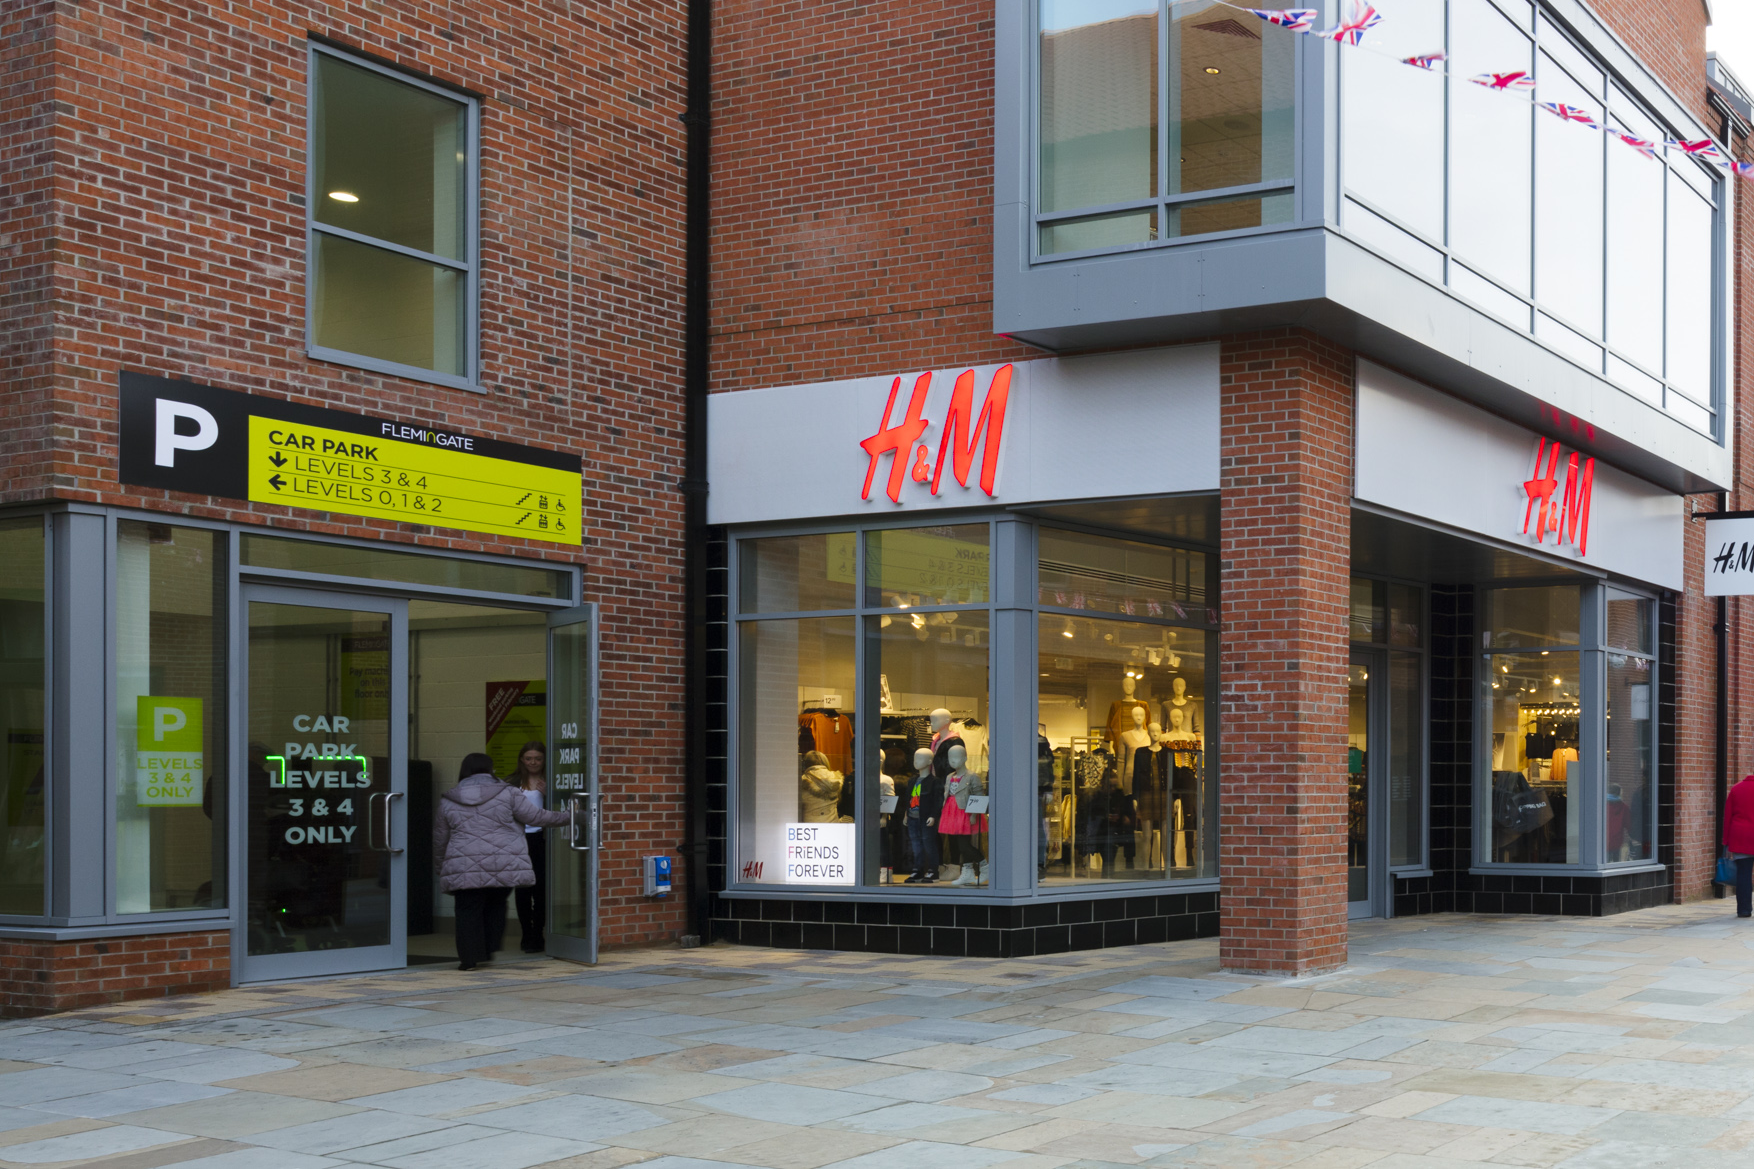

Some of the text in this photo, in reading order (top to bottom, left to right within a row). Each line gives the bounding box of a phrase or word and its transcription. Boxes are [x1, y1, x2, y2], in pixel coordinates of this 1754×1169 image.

[154, 397, 219, 468] P
[381, 422, 474, 451] FLEMINGATE
[859, 363, 1014, 504] H&M
[268, 430, 379, 462] CAR PARK
[294, 455, 428, 490] LEVELS 3 & 4
[293, 477, 442, 513] LEVELS 0, 1 & 2
[1522, 436, 1595, 557] H&M
[488, 687, 506, 711] FREE
[153, 706, 188, 742] P
[292, 714, 351, 734] CAR
[284, 742, 358, 760] PARK
[137, 757, 203, 770] LEVELS
[148, 772, 192, 784] 3 & 4
[269, 770, 371, 789] LEVELS
[146, 786, 194, 798] ONLY
[288, 798, 354, 817] 3 & 4
[284, 825, 357, 845] ONLY
[788, 827, 819, 841] BEST
[742, 860, 764, 879] H&M
[788, 864, 844, 878] FOREVER
